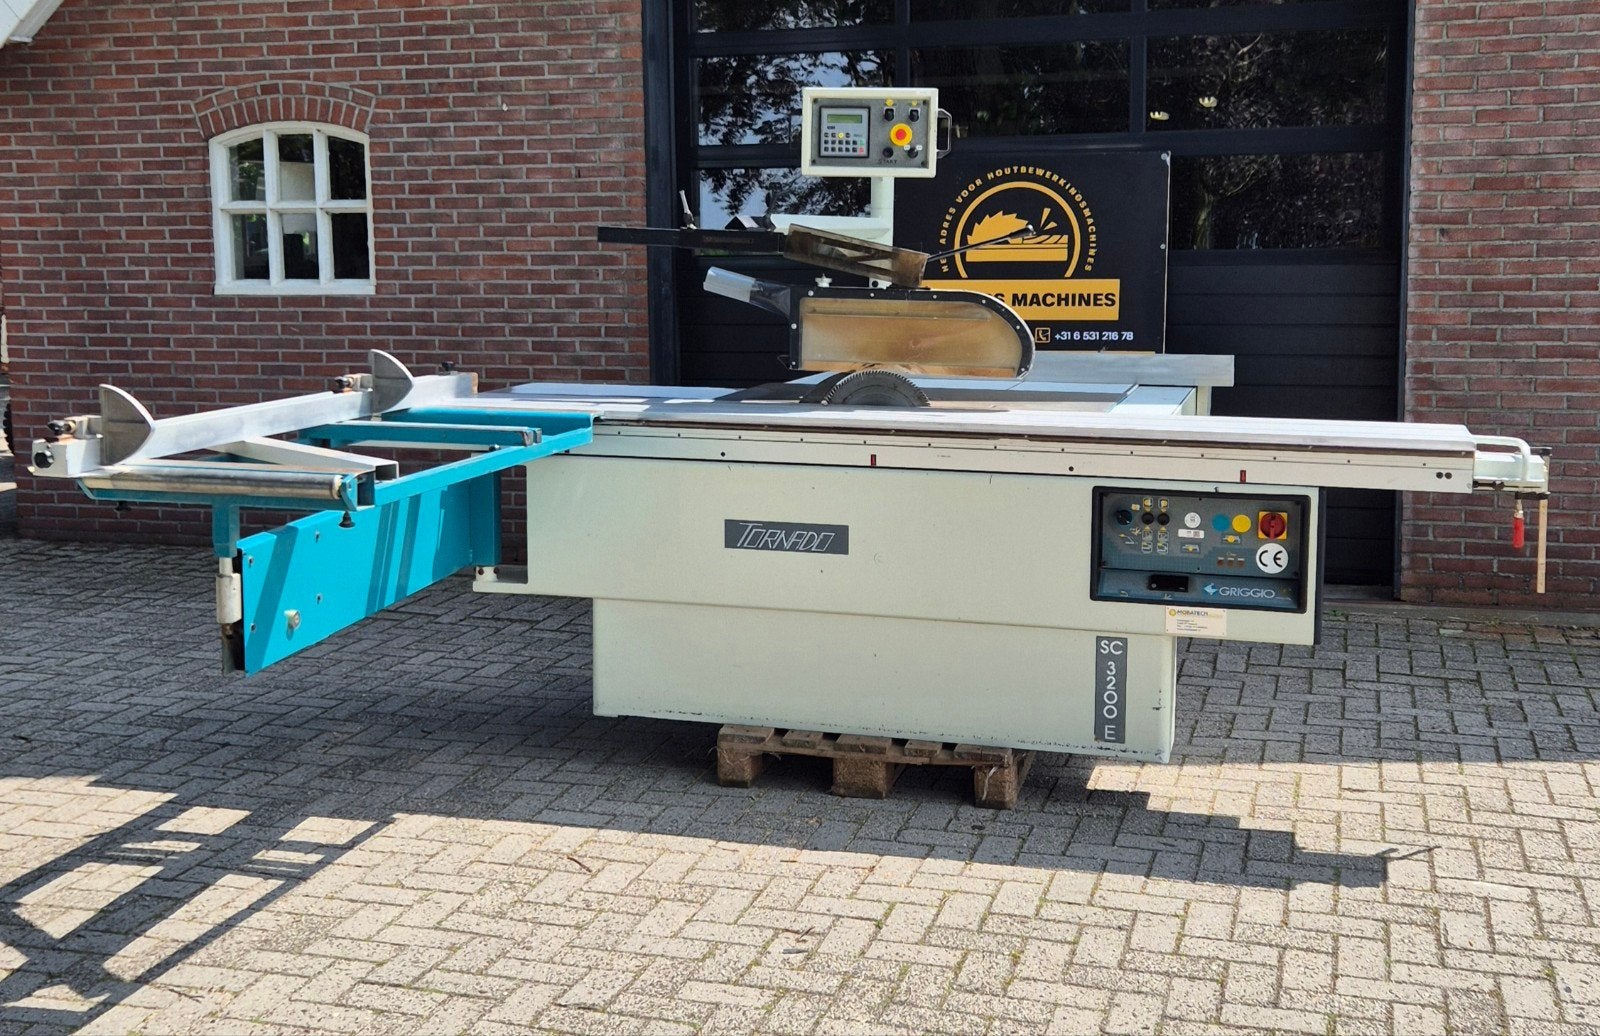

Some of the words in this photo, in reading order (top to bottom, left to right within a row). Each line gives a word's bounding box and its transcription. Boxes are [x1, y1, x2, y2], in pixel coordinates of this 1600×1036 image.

[939, 206, 956, 245] ADRES
[955, 178, 983, 204] VOOR
[1011, 293, 1116, 307] MACHINES
[1054, 331, 1071, 341] +31
[1073, 331, 1081, 341] 6
[1082, 331, 1100, 341] 531
[1101, 331, 1119, 341] 216
[1121, 331, 1134, 341] 78
[737, 522, 836, 552] TORNADO
[1219, 586, 1276, 599] GRIGGIO
[1100, 639, 1124, 655] SC
[1103, 661, 1118, 719] 3200
[1104, 725, 1116, 740] E
